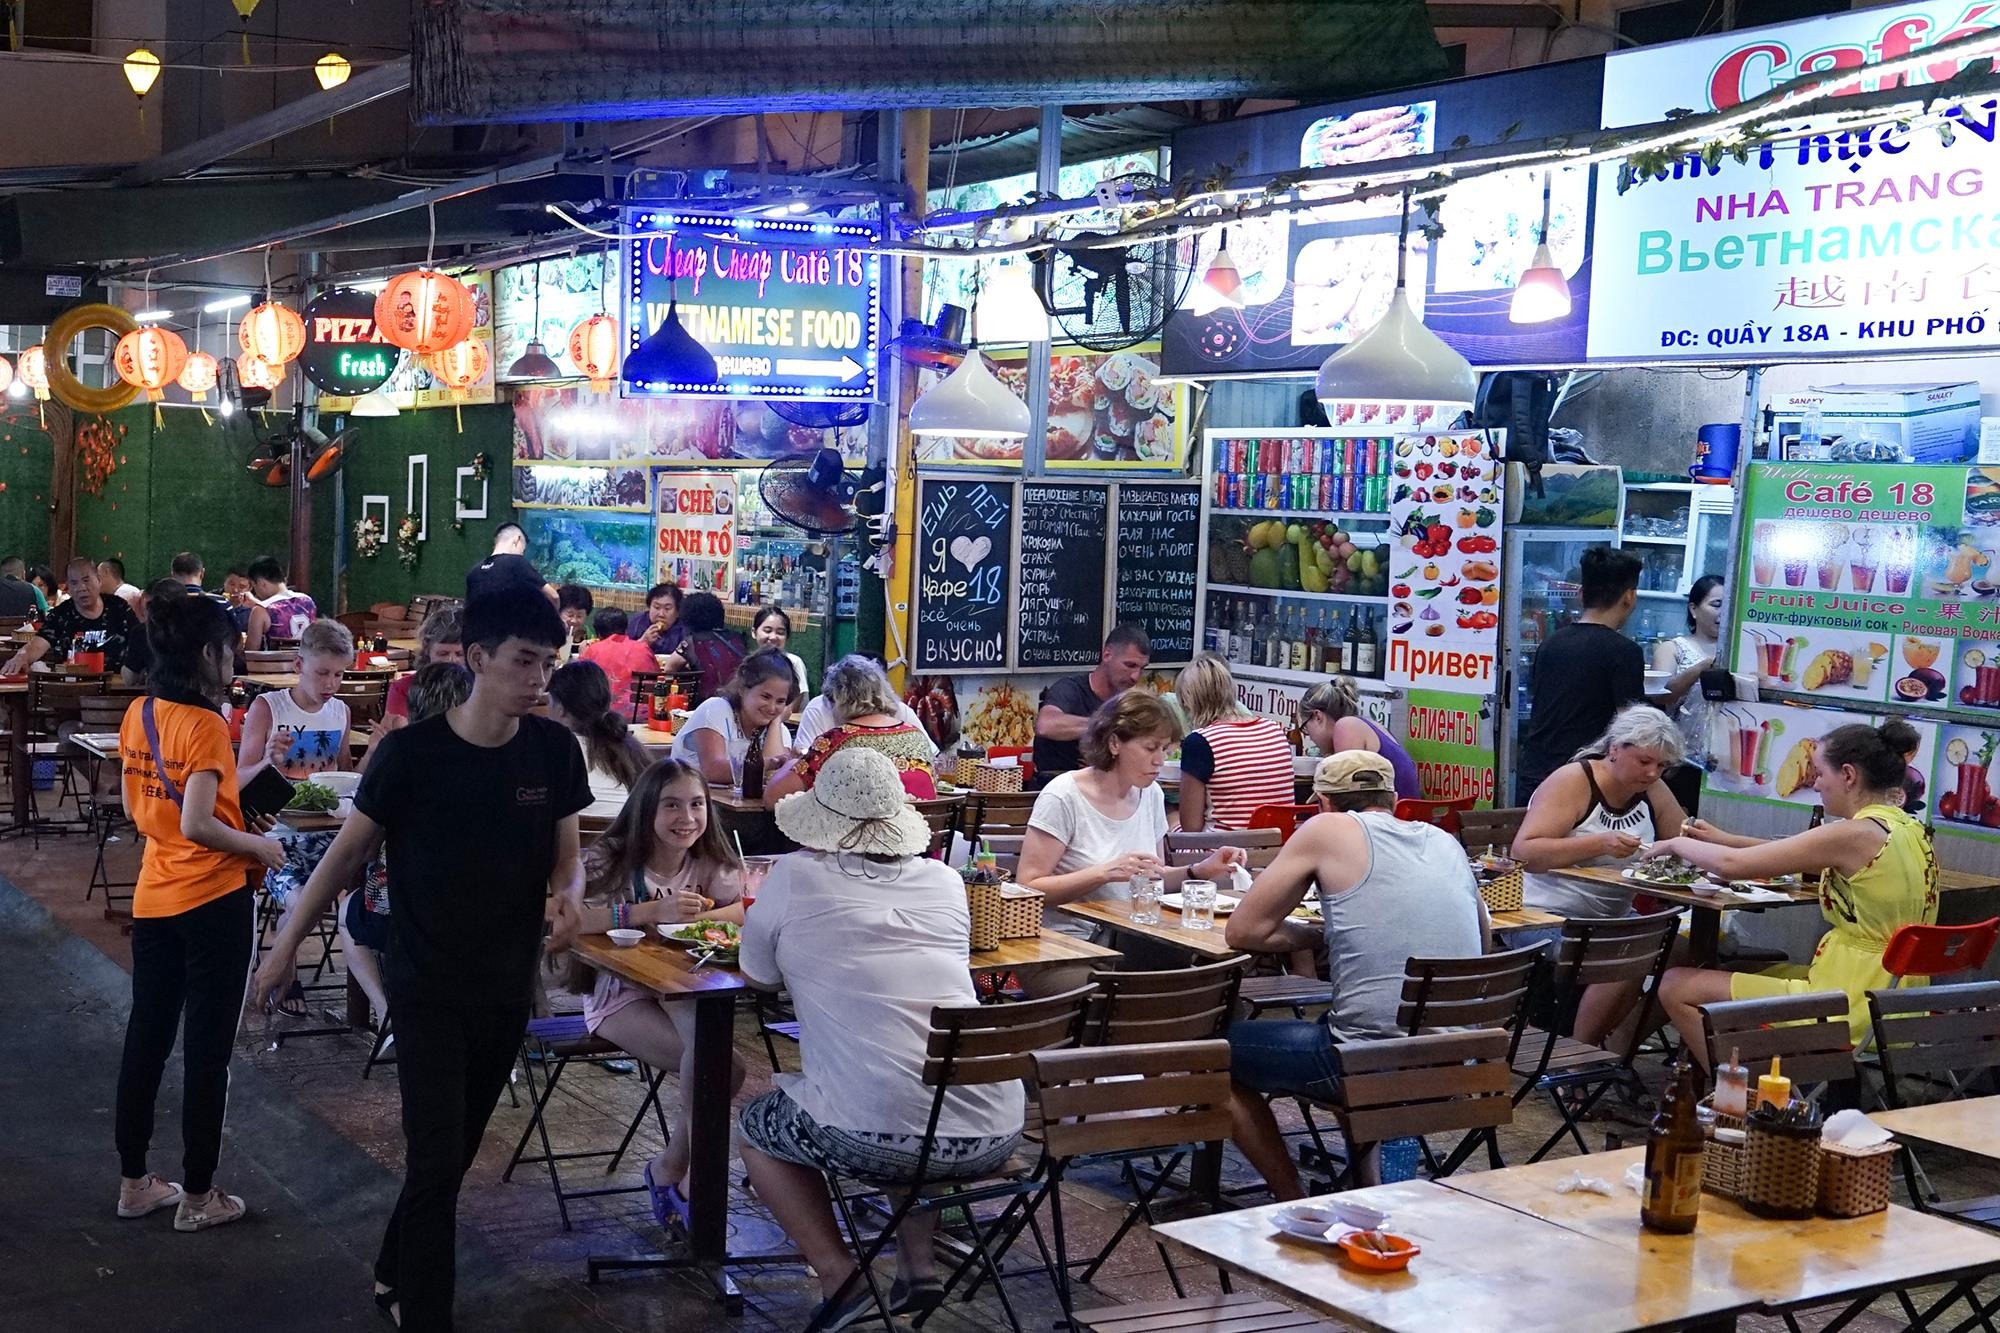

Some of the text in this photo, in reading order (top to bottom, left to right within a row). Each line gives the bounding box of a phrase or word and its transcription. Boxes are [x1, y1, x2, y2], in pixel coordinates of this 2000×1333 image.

[1696, 168, 1984, 223] NHA TRANG
[834, 249, 864, 287] 18
[801, 310, 862, 349] FOOD
[1661, 329, 1699, 347] ĐC:
[1707, 319, 1772, 347] QUẦY
[1782, 323, 1830, 343] 18A
[1858, 319, 1915, 339] KHU
[1926, 308, 1989, 336] PHỐ
[341, 353, 386, 377] Fresh
[678, 483, 715, 515] CHÈ
[1785, 479, 1936, 507] Café 18
[1784, 506, 1932, 522] дешево дешево
[659, 528, 703, 555] SINH
[1151, 527, 1176, 540] НАС
[968, 565, 1002, 604] 18
[1750, 590, 1815, 609] Fruit
[1824, 596, 1906, 615] Juice
[1747, 608, 1862, 630] Фрукт-фруктовый
[1902, 620, 1958, 638] Рисовая
[926, 631, 1003, 662] ВКУСНО!
[1390, 640, 1494, 681] Привет
